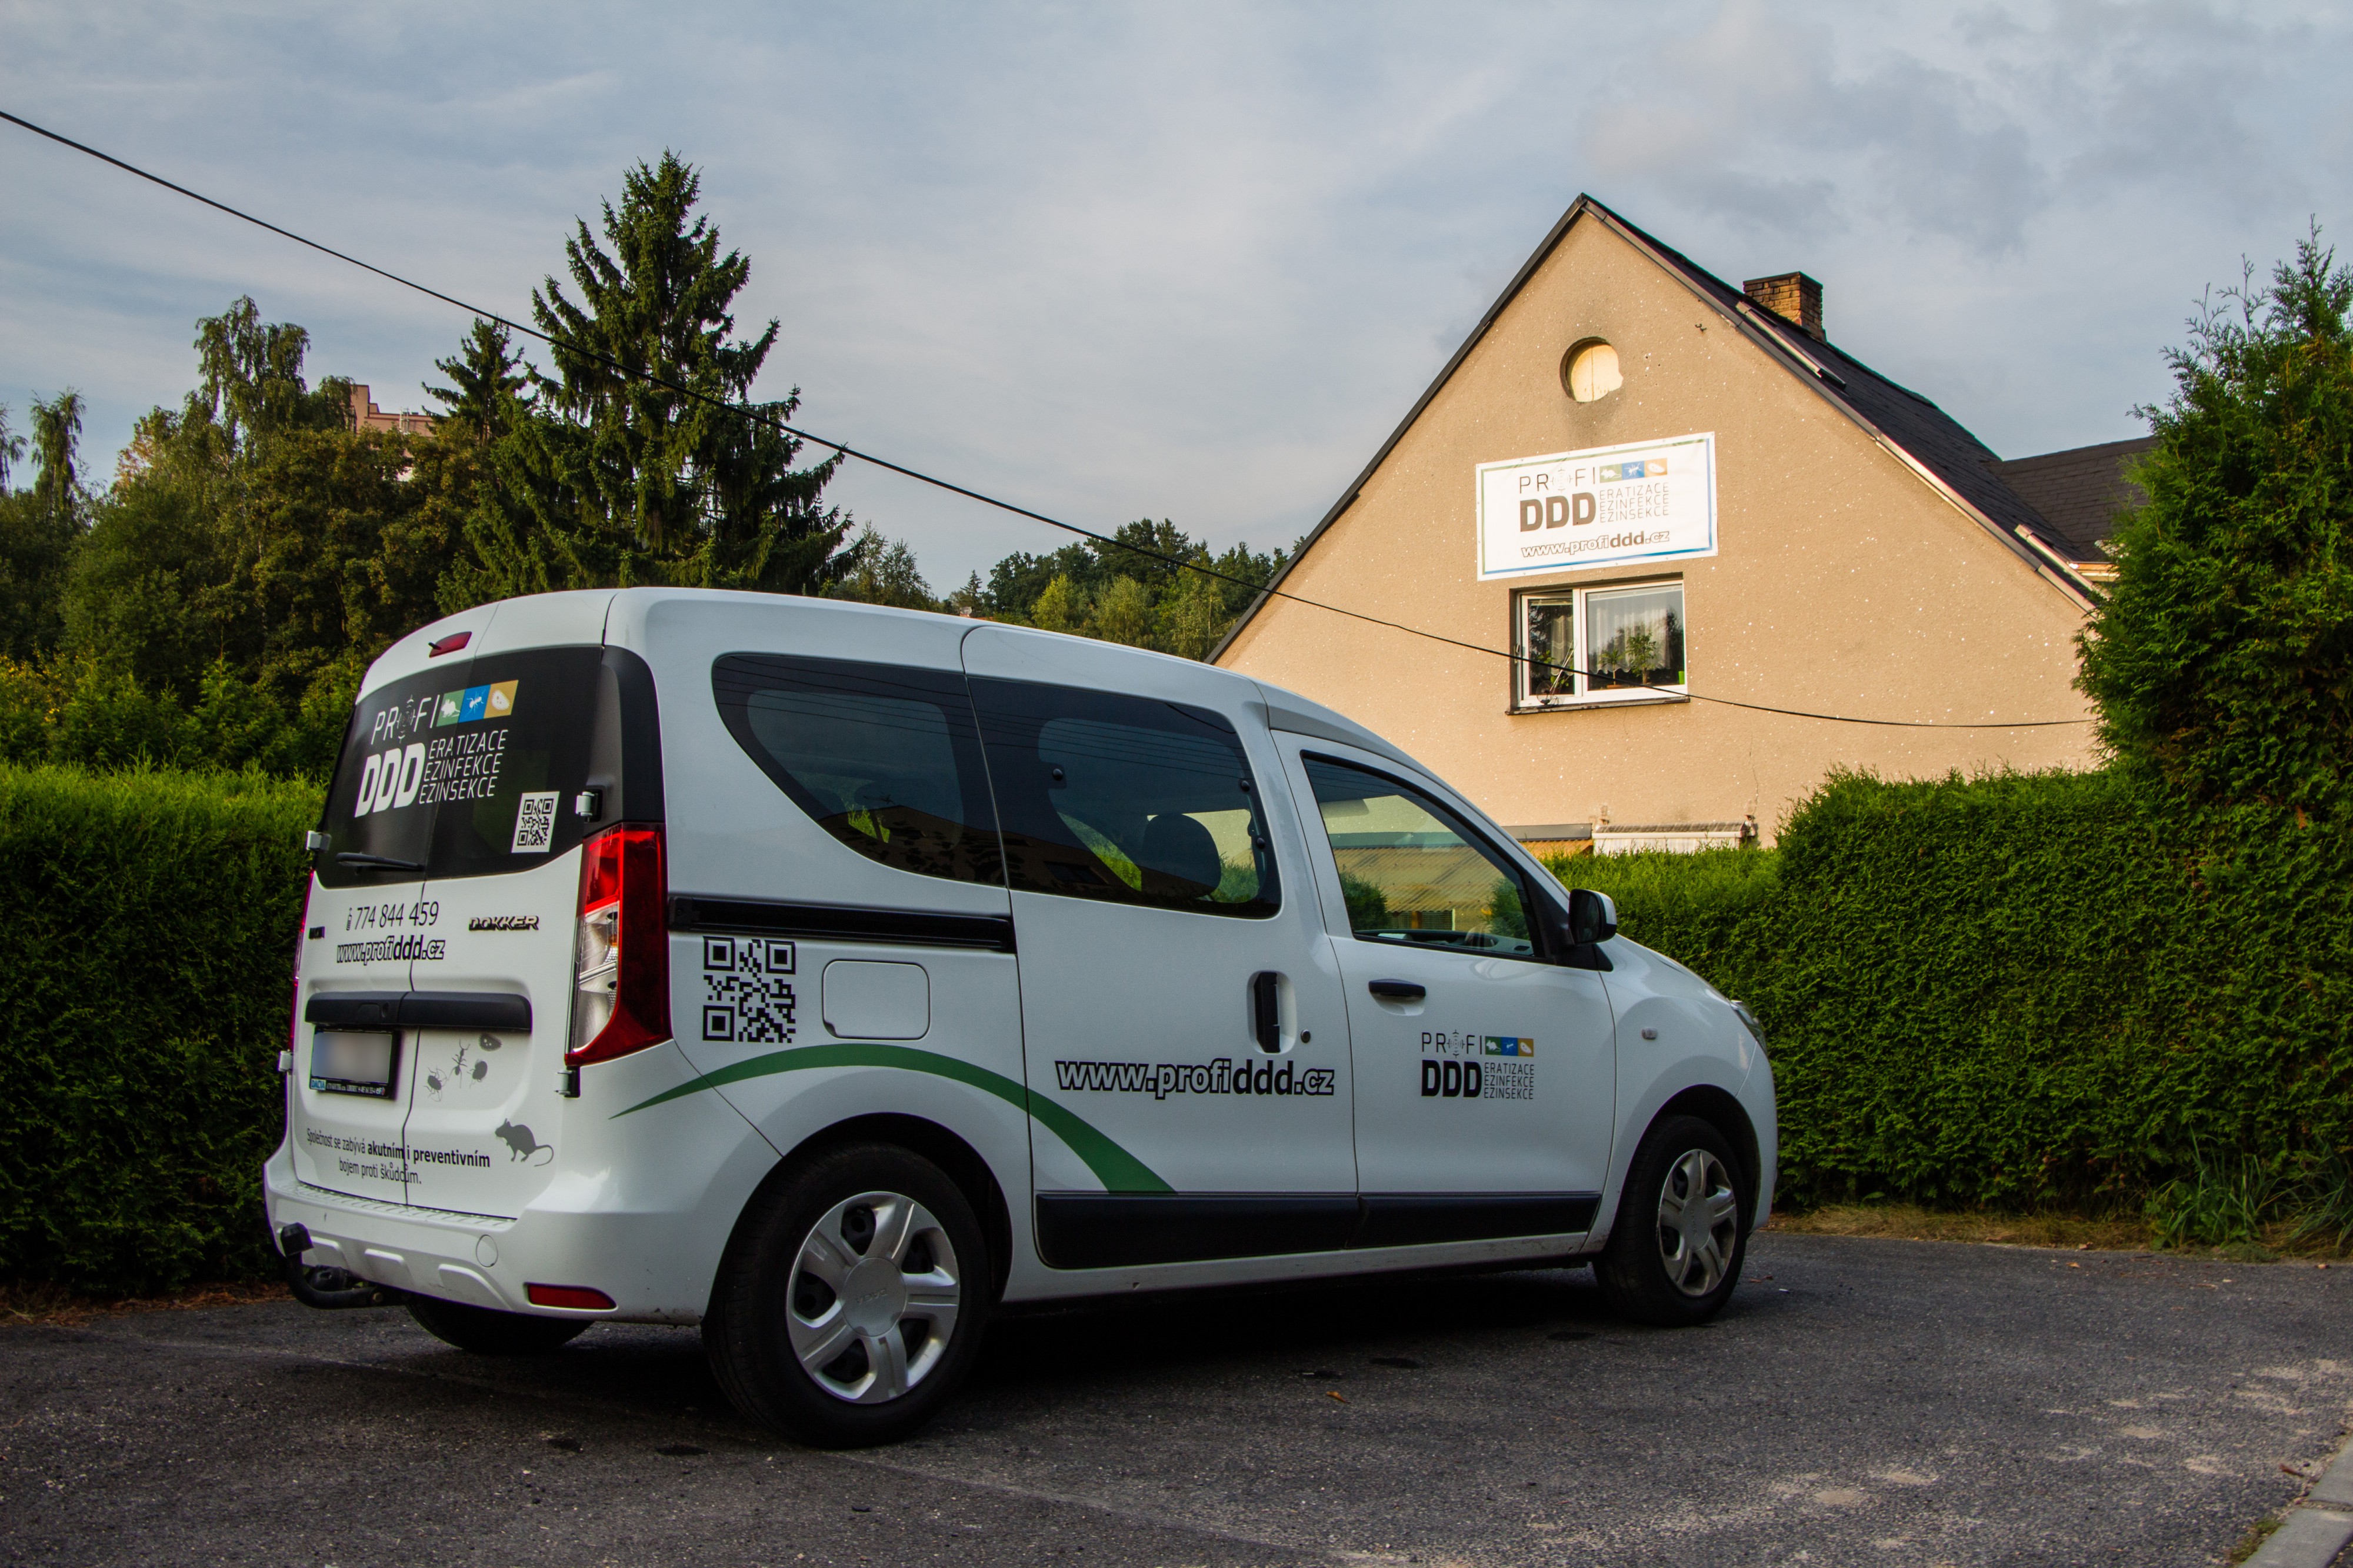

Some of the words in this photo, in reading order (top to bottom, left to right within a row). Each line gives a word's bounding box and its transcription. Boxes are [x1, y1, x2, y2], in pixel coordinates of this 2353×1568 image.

[1599, 482, 1669, 501] ERATIZACE
[1599, 493, 1669, 512] EZINFEKCE
[1520, 492, 1597, 532] DDD
[1599, 505, 1669, 523] EZINSEKCE
[1521, 531, 1670, 558] www.profiddd.cz
[429, 729, 508, 759] ERATIZACE
[354, 743, 426, 818] DDD
[424, 753, 503, 782] EZINFEKCE
[419, 776, 498, 804] EZINSEKCE
[355, 906, 376, 930] 774
[379, 903, 404, 928] 844
[409, 901, 439, 926] 459
[469, 916, 539, 930] DOKKER
[337, 935, 446, 966] www.profiddd.cz
[1055, 1057, 1335, 1100] www.profiddd.cz
[1421, 1059, 1482, 1098] DDD
[1484, 1062, 1535, 1075] ERATIZACE
[1484, 1075, 1534, 1087] EZINFEKCE
[1484, 1087, 1534, 1100] EZINSEKCE
[307, 1127, 332, 1147] Společnost
[334, 1136, 341, 1149] se
[342, 1137, 365, 1155] zabývá
[368, 1140, 405, 1159] akutním
[413, 1149, 491, 1167] preventivním
[339, 1156, 359, 1176] bojem
[362, 1163, 378, 1179] proti
[381, 1162, 422, 1184] škůdcům.
